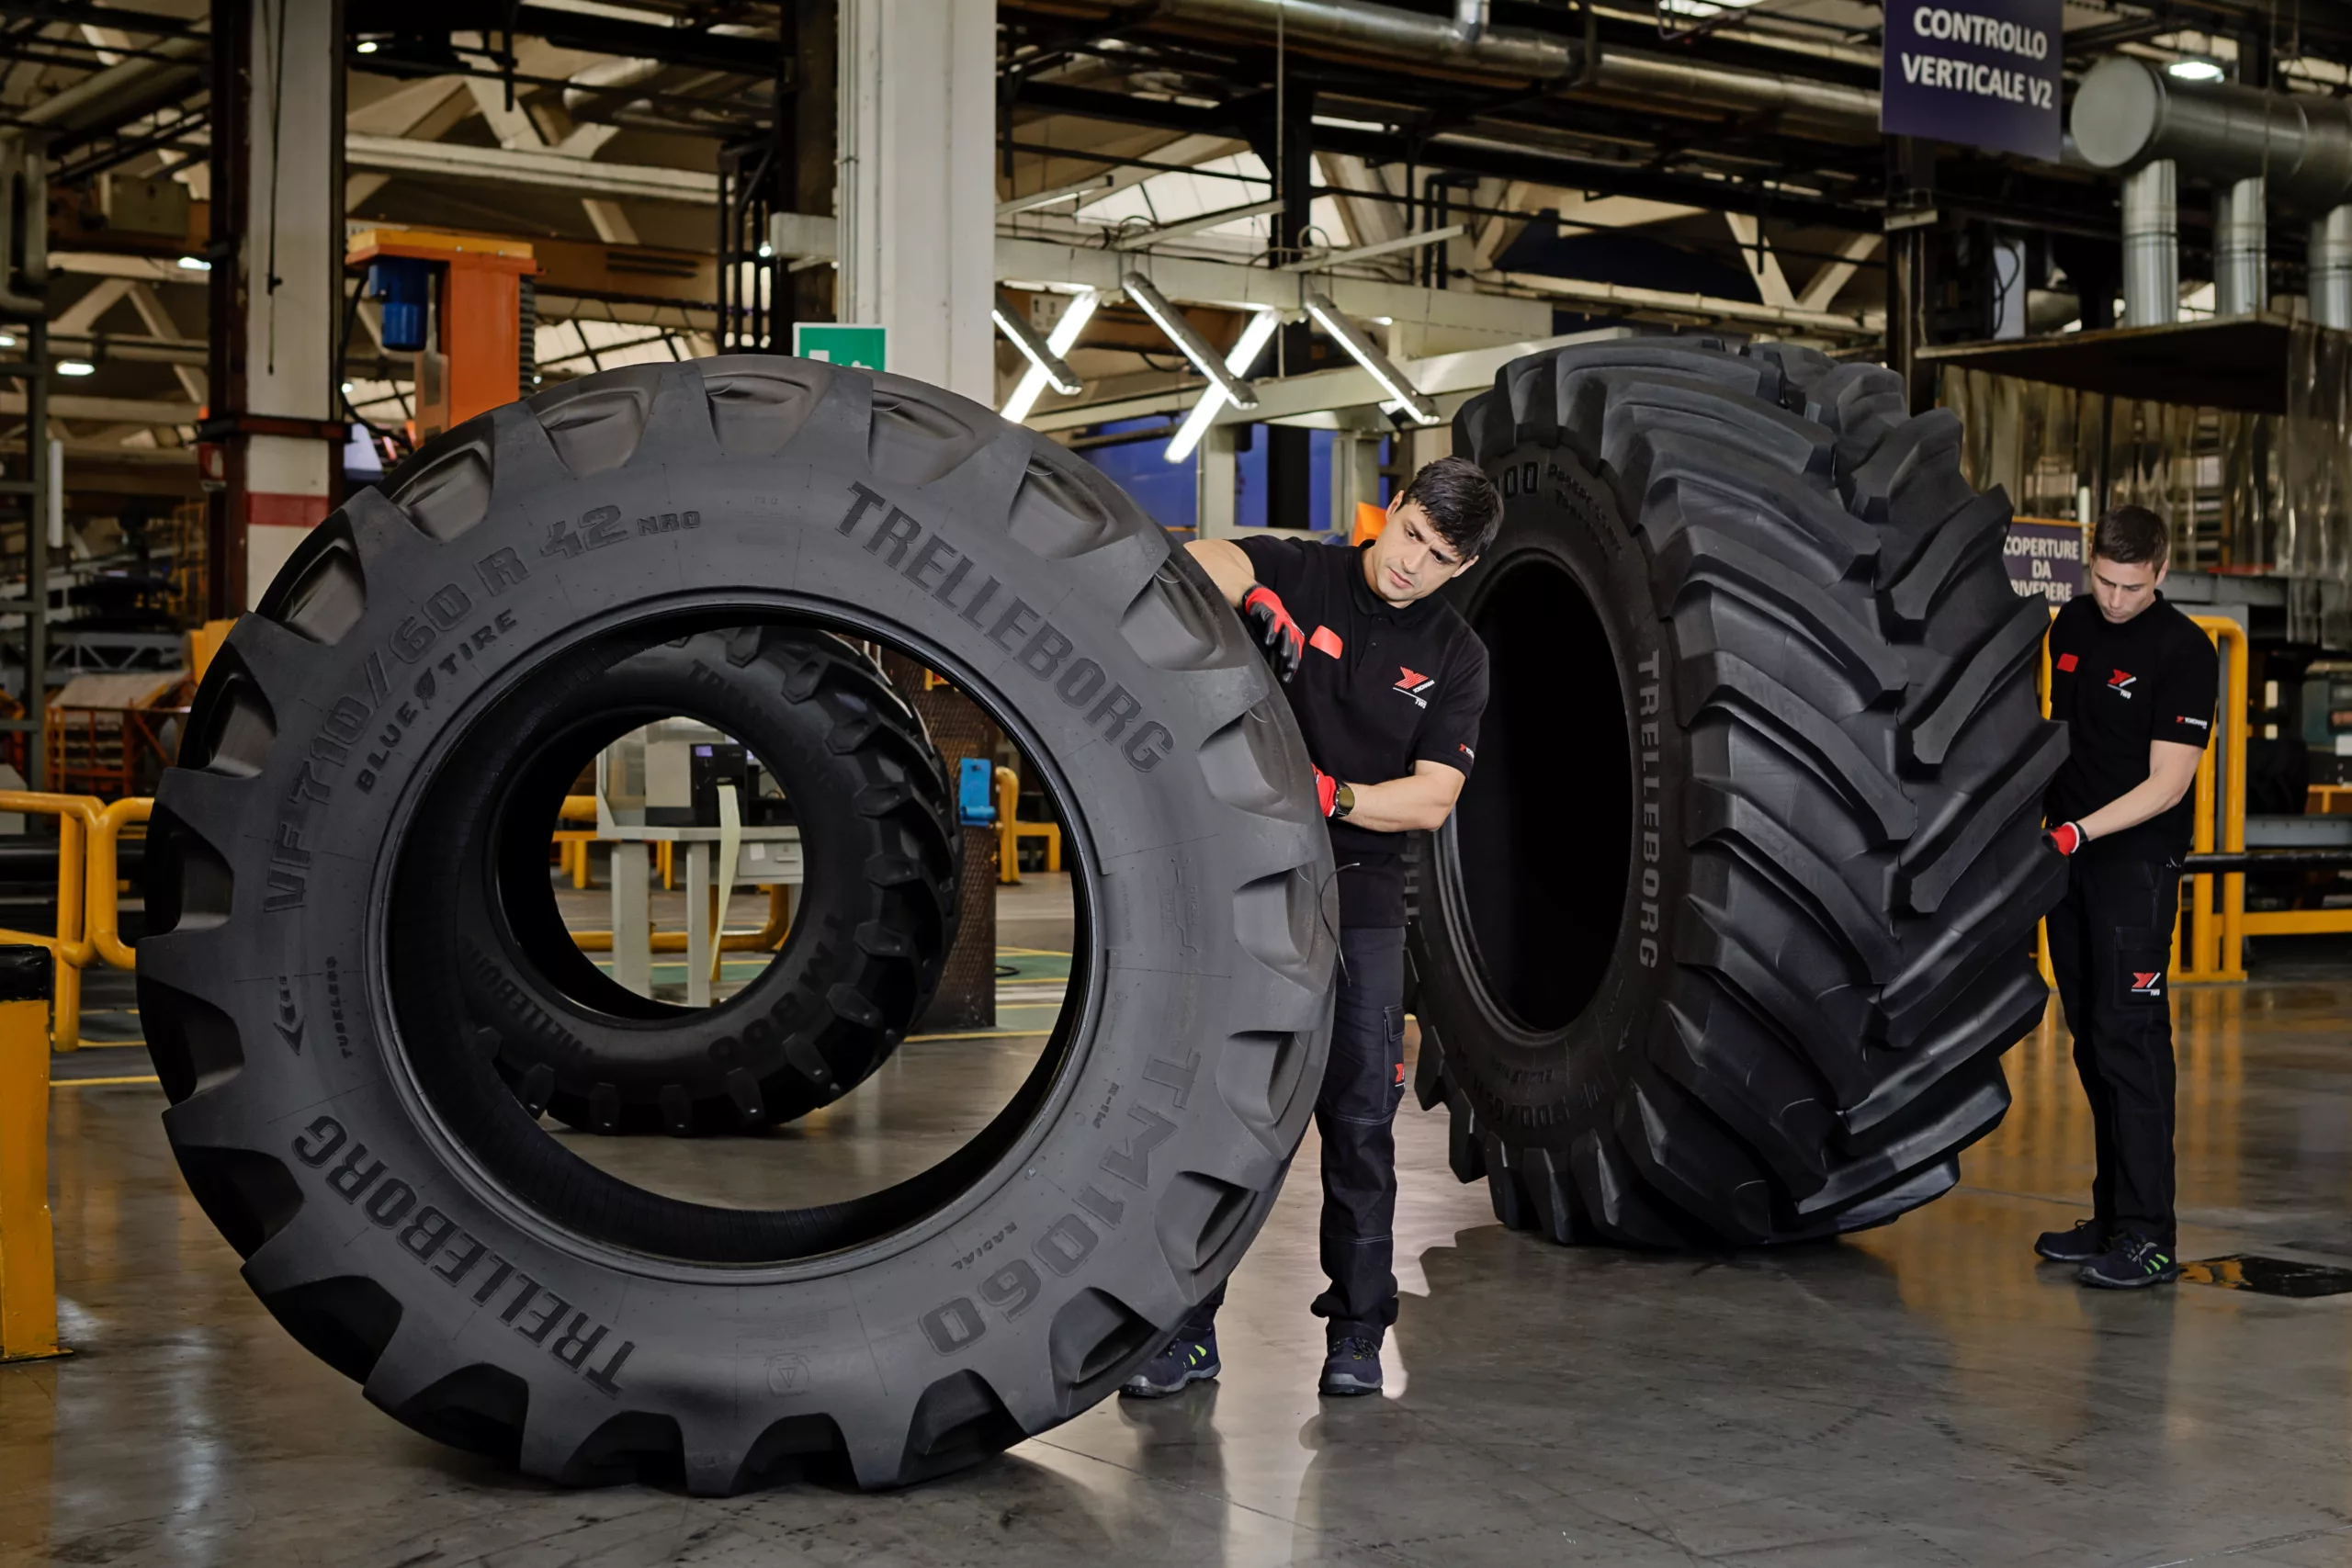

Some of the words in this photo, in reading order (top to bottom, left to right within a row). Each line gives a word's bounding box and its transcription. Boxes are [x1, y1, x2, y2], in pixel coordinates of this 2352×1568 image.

[1900, 51, 2026, 103] VERTICALE
[2028, 75, 2053, 110] V2
[1913, 6, 2048, 61] CONTROLLO
[835, 479, 1176, 773] TRELLEBORG
[2003, 536, 2080, 560] COPERTURE
[2031, 558, 2052, 581] DA
[263, 822, 311, 913] VF
[287, 582, 475, 806] 710/60
[472, 547, 531, 597] R
[539, 504, 630, 558] 42
[637, 510, 702, 536] NRO
[355, 700, 421, 795] BLUE
[436, 608, 519, 677] TIRE
[1636, 649, 1660, 968] TRELLEBORG
[290, 1114, 637, 1399] TRELLEBORG
[919, 1048, 1202, 1356] TM1060
[950, 1221, 1018, 1270] RADIAL
